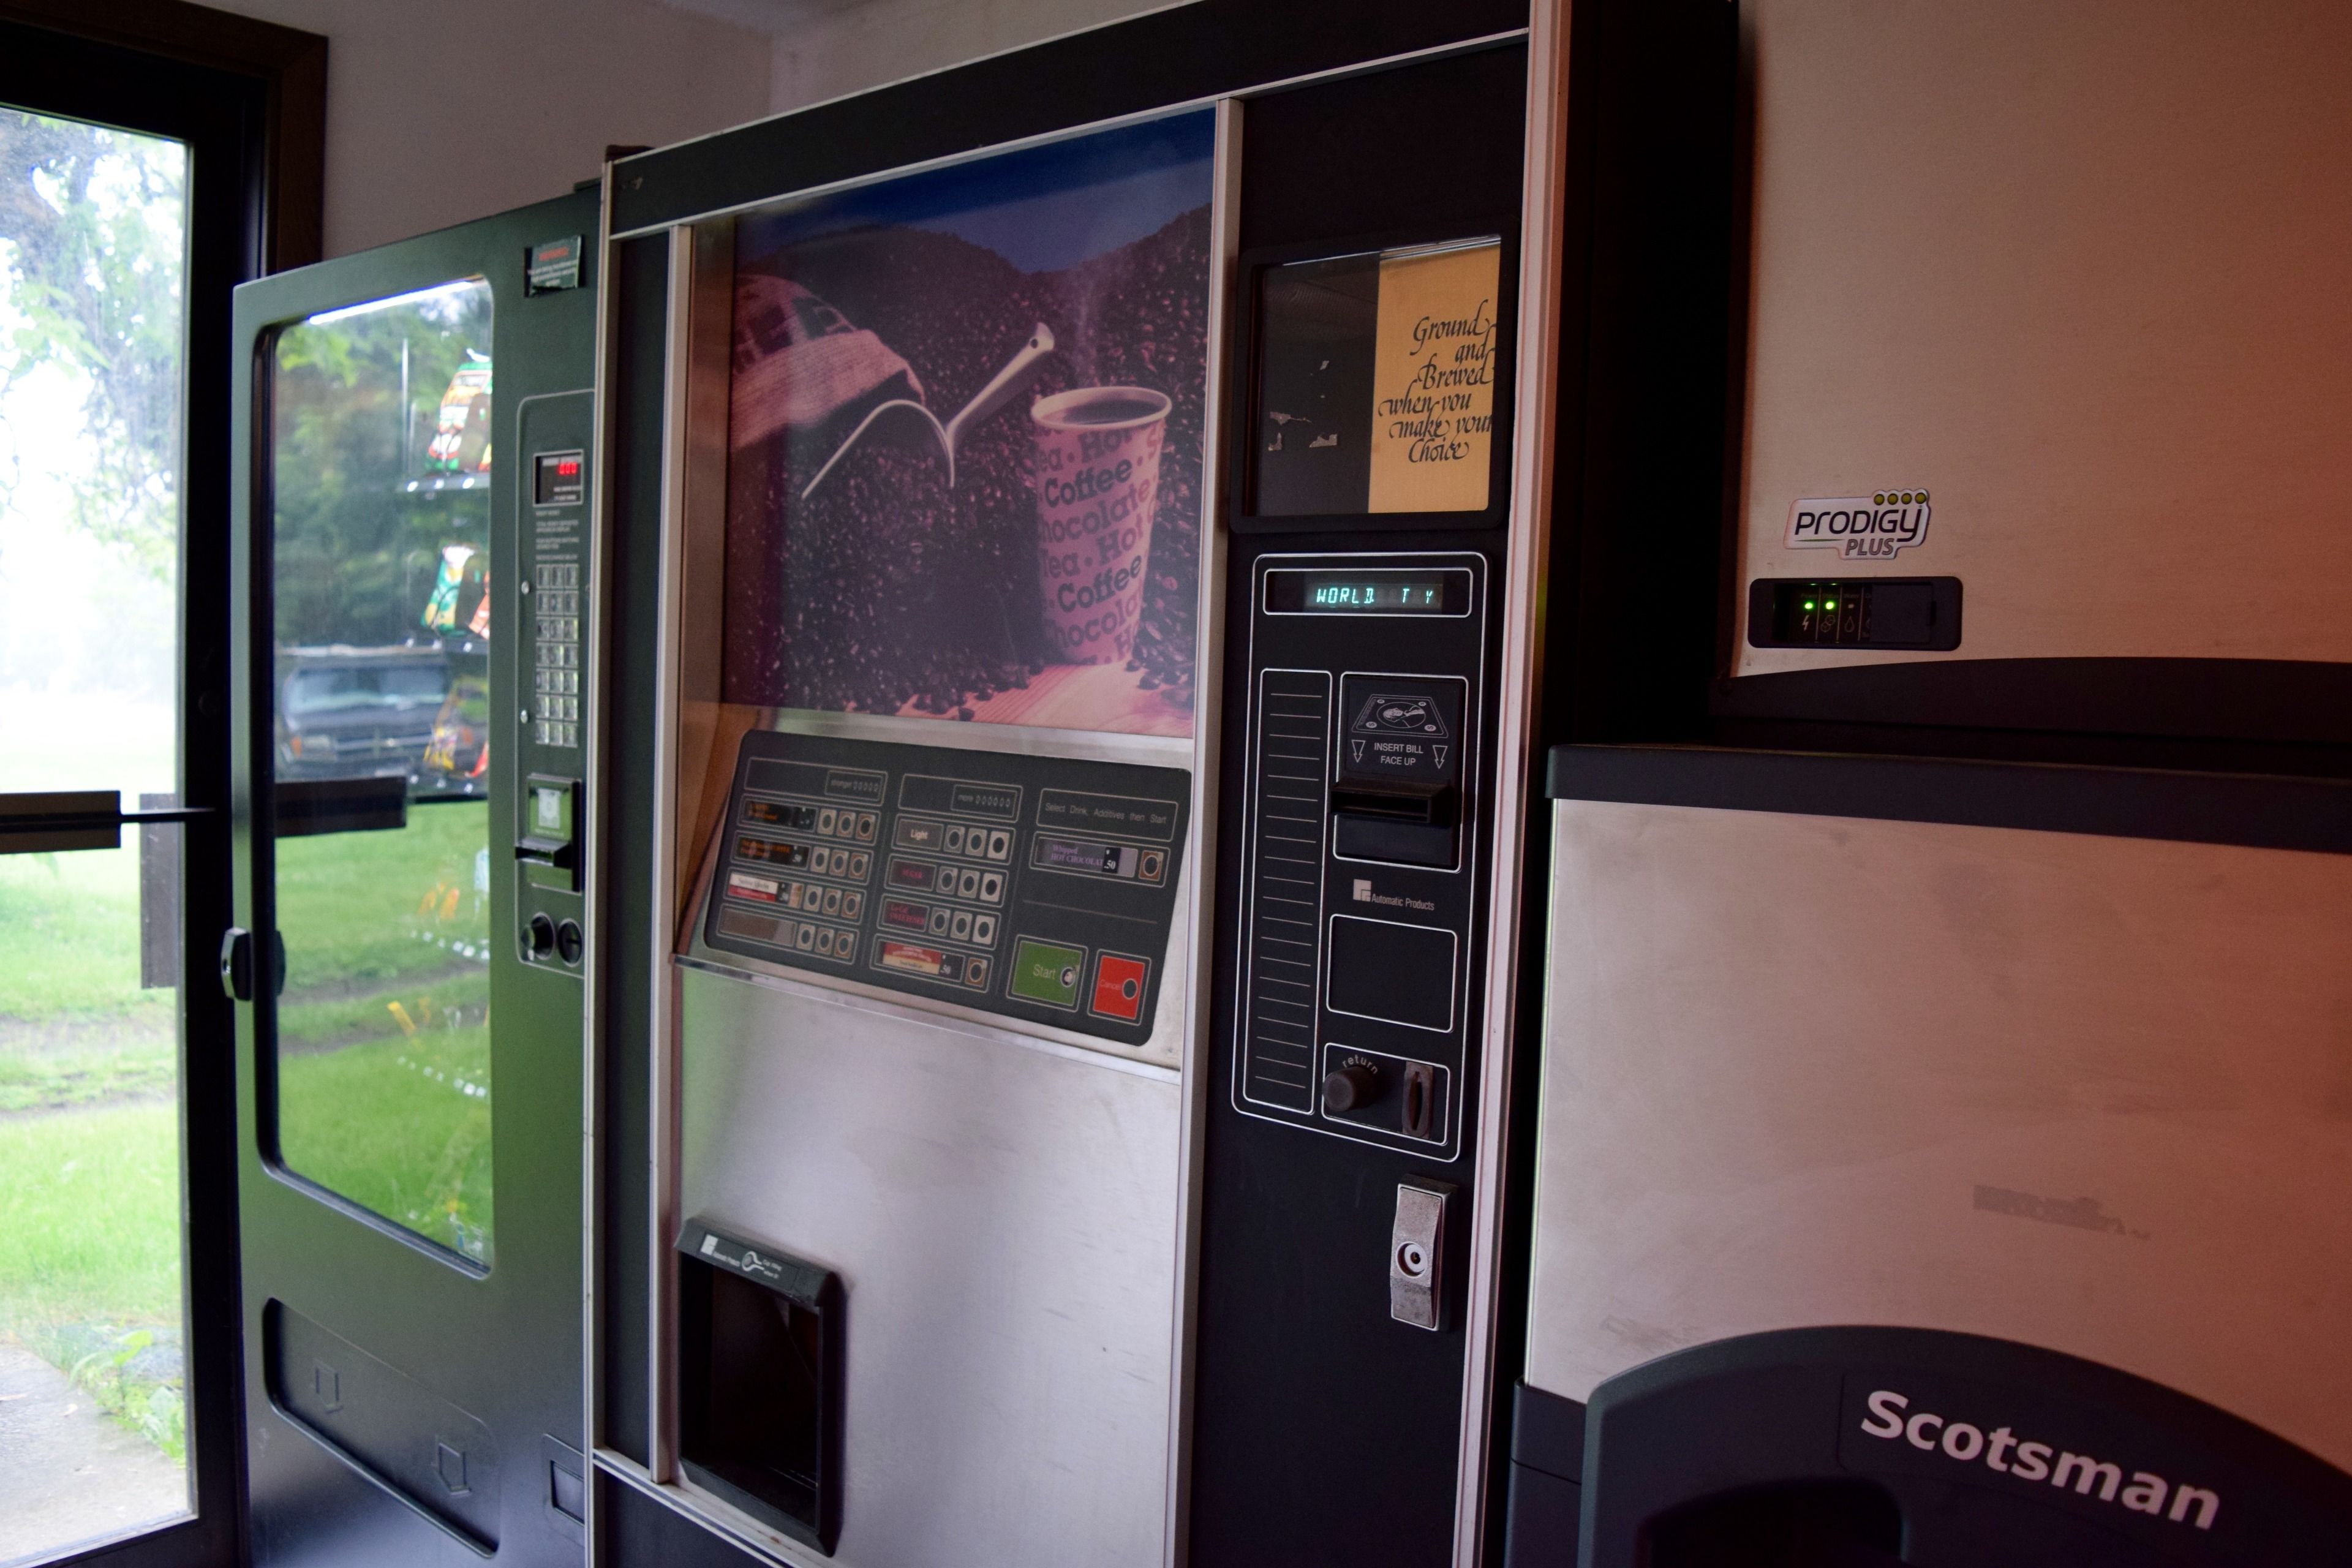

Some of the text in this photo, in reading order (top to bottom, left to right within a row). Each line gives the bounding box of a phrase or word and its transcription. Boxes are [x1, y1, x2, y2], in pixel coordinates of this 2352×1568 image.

[1410, 299, 1490, 356] Ground
[1454, 323, 1496, 369] and
[1417, 347, 1496, 390] Brewed
[1378, 379, 1434, 417] when
[1389, 401, 1450, 439] make
[1409, 435, 1469, 463] Choice
[1045, 459, 1133, 508] Coffee
[1845, 538, 1894, 556] PLUS
[1057, 554, 1142, 613] Coffee
[1402, 587, 1411, 604] T
[1425, 590, 1434, 605] Y
[1374, 742, 1423, 754] INSERT BILL
[1381, 755, 1416, 766] FACE UP
[1045, 802, 1066, 813] Select
[1093, 808, 1125, 820] Additives
[1129, 811, 1145, 822] then
[1150, 814, 1167, 824] Start
[910, 828, 929, 840] Light
[1050, 853, 1065, 862] HOT
[1371, 894, 1435, 911] Automatic Products
[1033, 963, 1056, 980] Start
[1341, 1054, 1379, 1075] return
[1860, 1389, 2220, 1530] Scotsman
